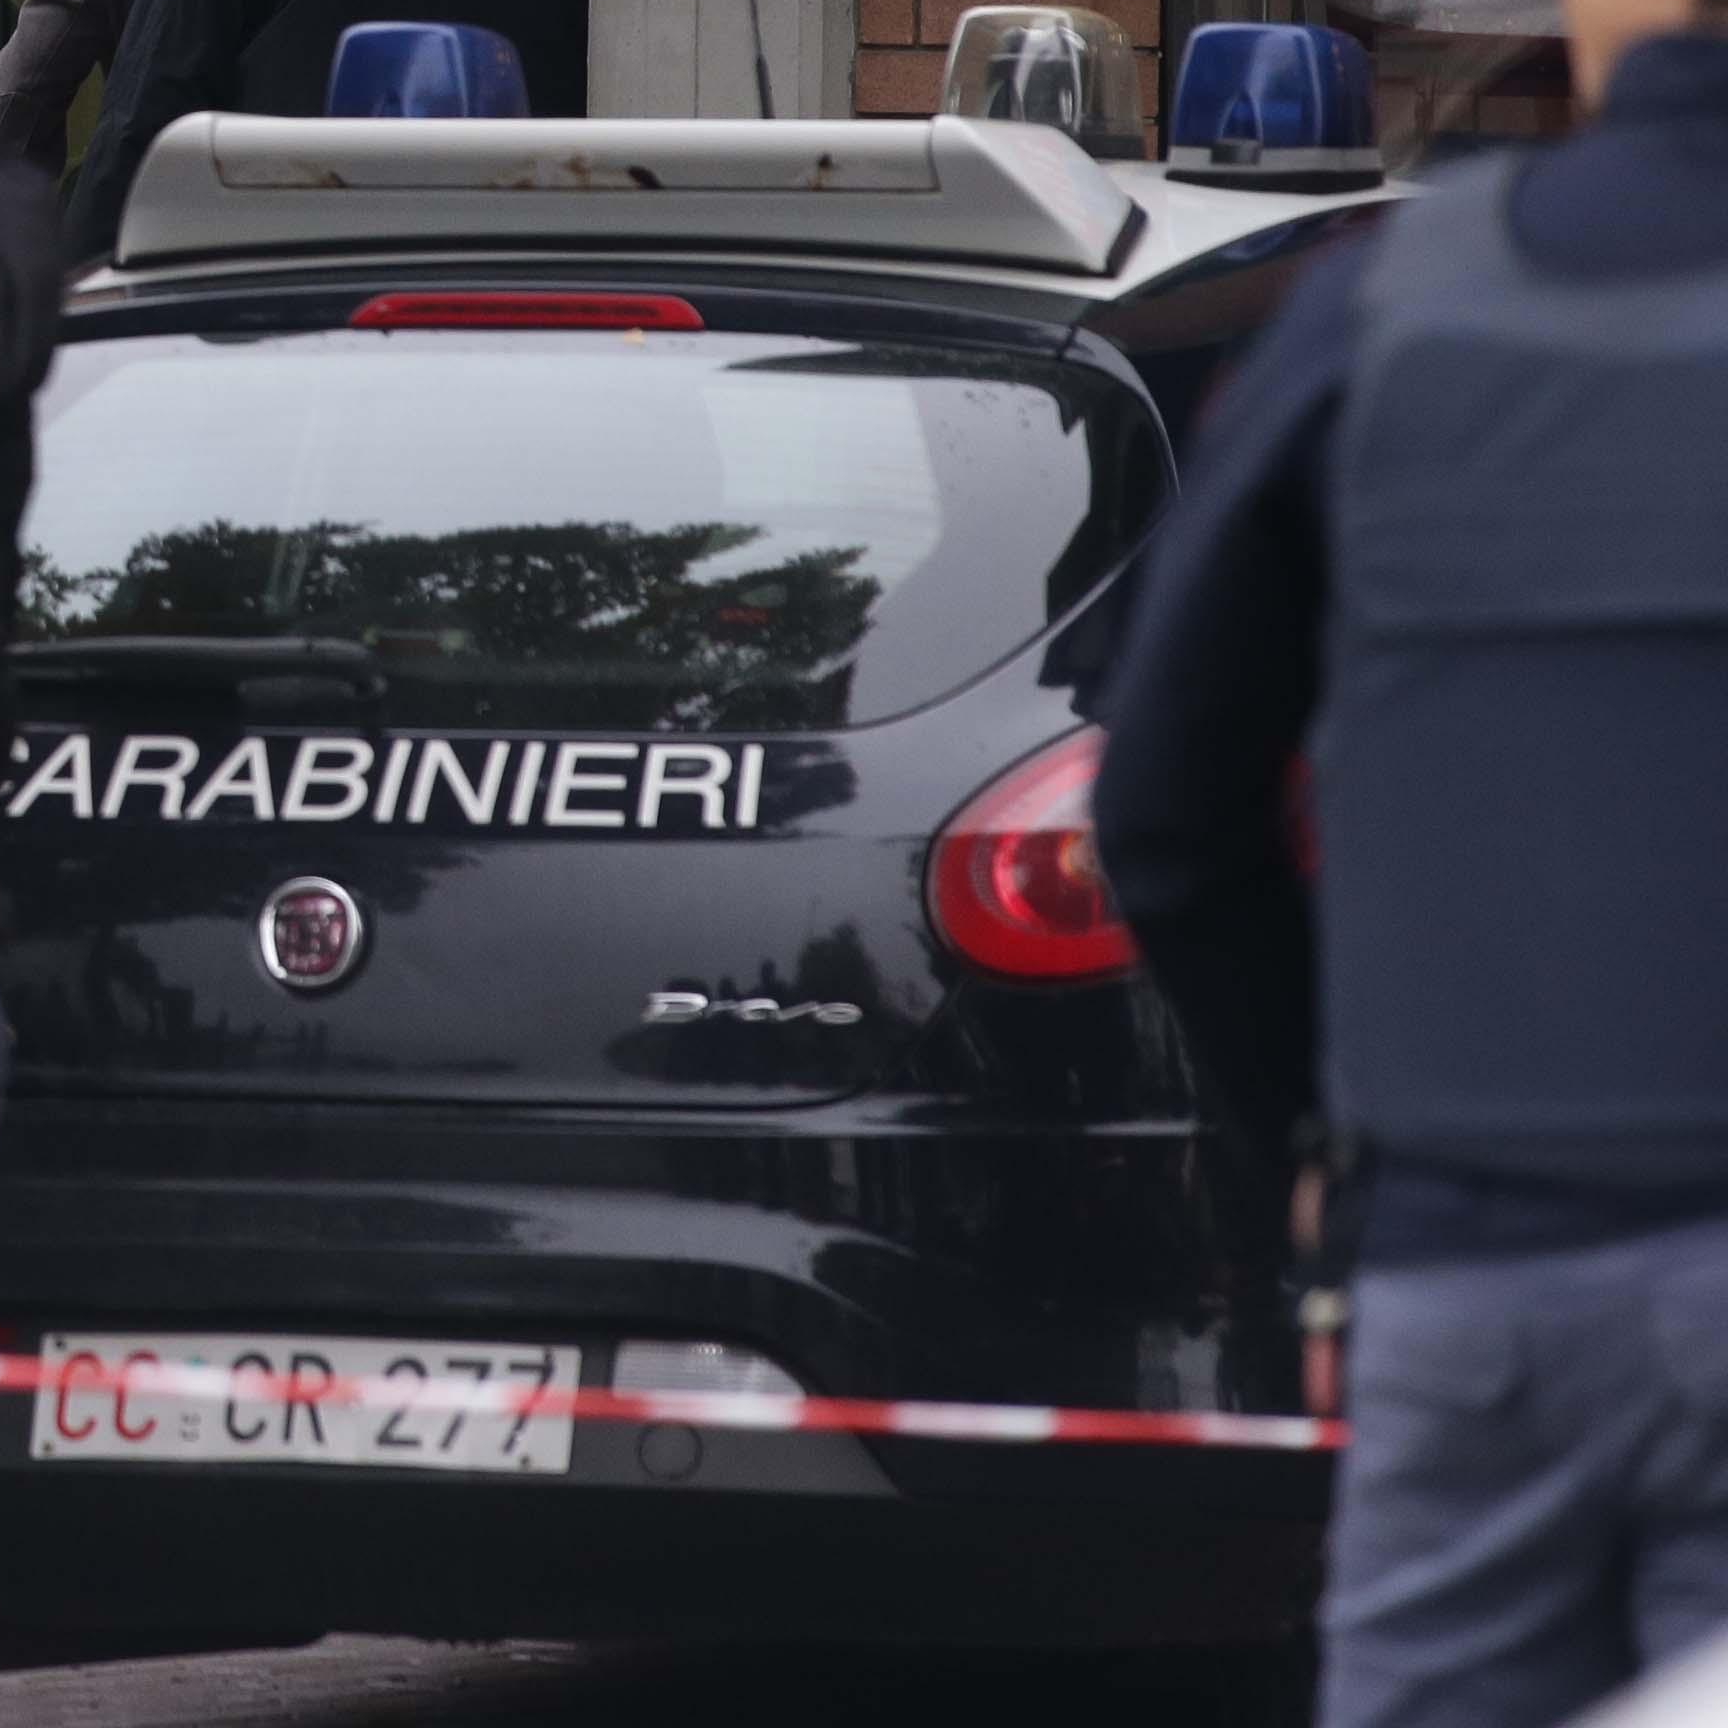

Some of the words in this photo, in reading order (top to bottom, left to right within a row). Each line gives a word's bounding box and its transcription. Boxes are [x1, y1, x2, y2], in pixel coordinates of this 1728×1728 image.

[54, 1349, 161, 1443] CC
[223, 1350, 328, 1447] CR
[374, 1353, 554, 1456] 277
